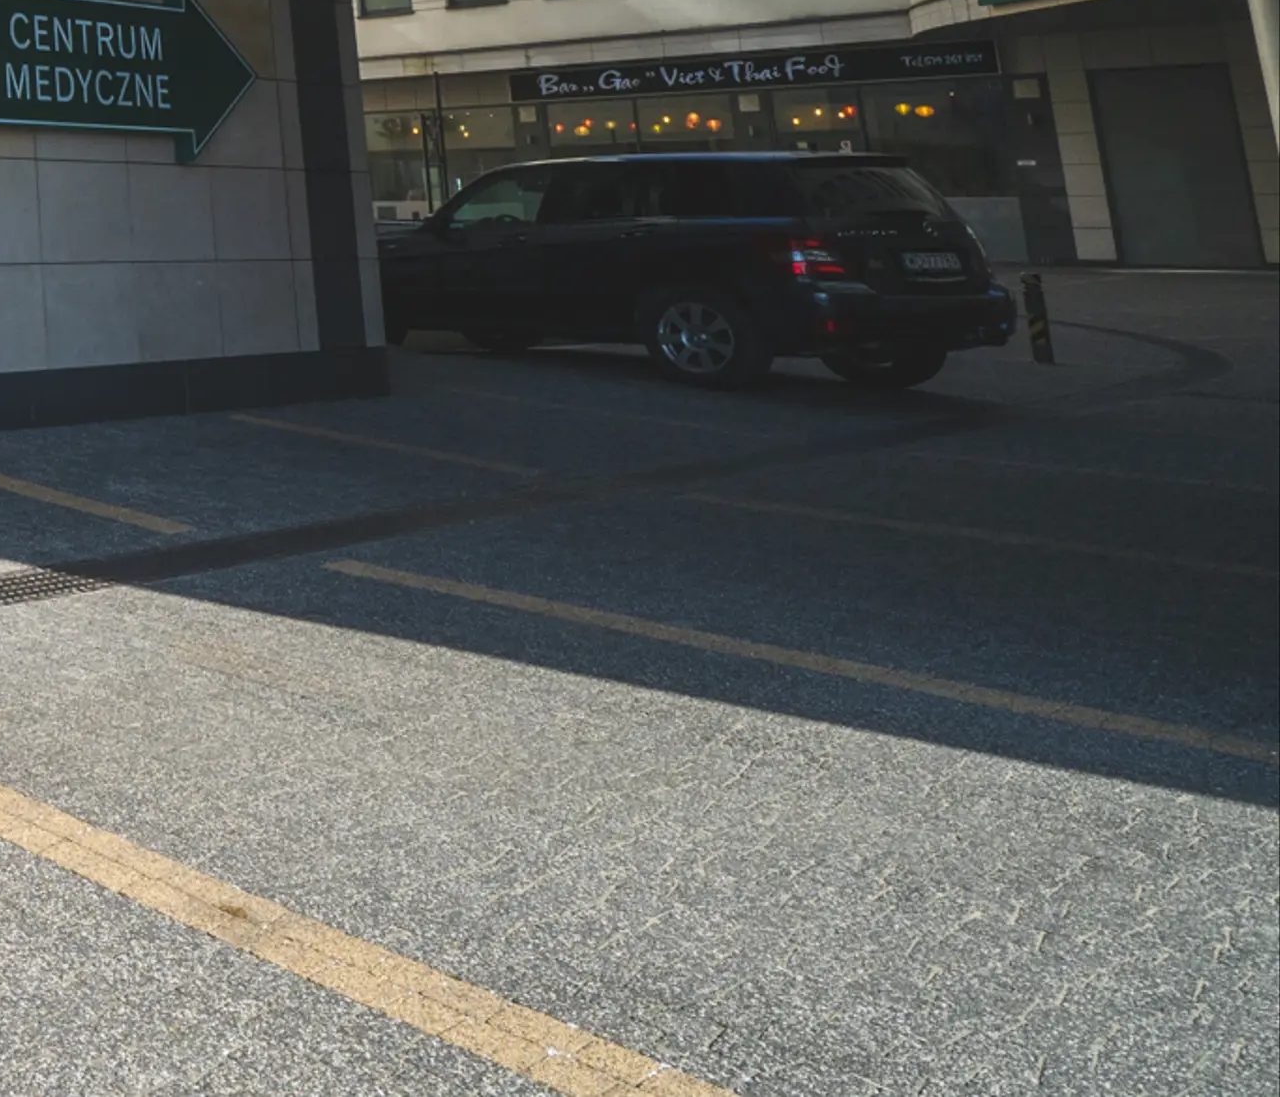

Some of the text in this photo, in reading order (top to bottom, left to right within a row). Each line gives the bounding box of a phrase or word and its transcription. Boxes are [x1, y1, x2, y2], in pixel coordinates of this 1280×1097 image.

[9, 12, 164, 61] CENTRUM
[5, 62, 172, 110] MEDYCZNE
[723, 59, 782, 84] Thai
[785, 53, 845, 83] Food
